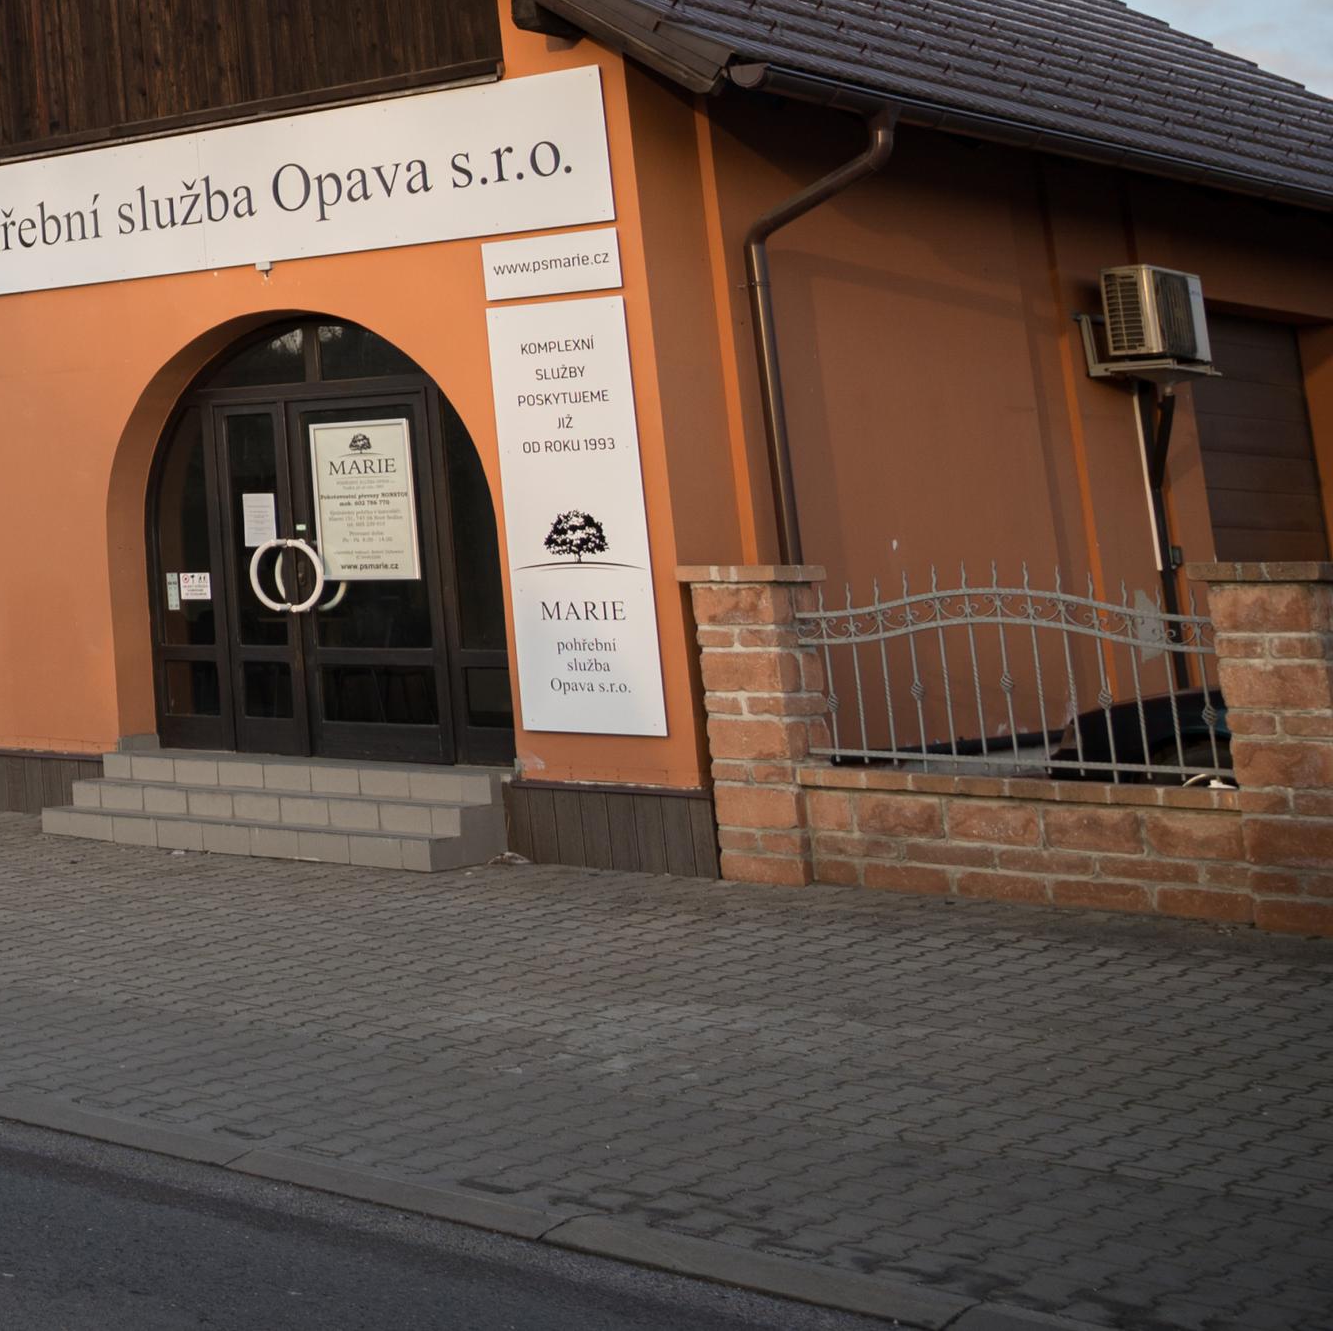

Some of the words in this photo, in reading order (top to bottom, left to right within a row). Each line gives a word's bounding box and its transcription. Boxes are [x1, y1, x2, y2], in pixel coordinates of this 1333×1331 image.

[117, 175, 257, 236] služba
[271, 157, 433, 222] Opava
[450, 140, 573, 189] s.r.o.
[493, 252, 609, 276] www.psmarie.cz
[520, 335, 594, 355] KOMPLEXNÍ
[535, 364, 585, 381] SLUŽBY
[517, 389, 610, 407] POSKYTUJEME
[557, 414, 573, 429] JIŽ
[522, 441, 541, 454] OD
[544, 439, 580, 453] ROKU
[584, 437, 615, 451] 1993
[328, 457, 397, 476] MARIE
[341, 562, 399, 571] www.psmarie.cz
[540, 600, 627, 621] MARIE
[557, 637, 617, 655] pohřební
[567, 658, 611, 672] služba
[550, 677, 595, 695] Opava
[598, 682, 632, 694] s.r.o.
